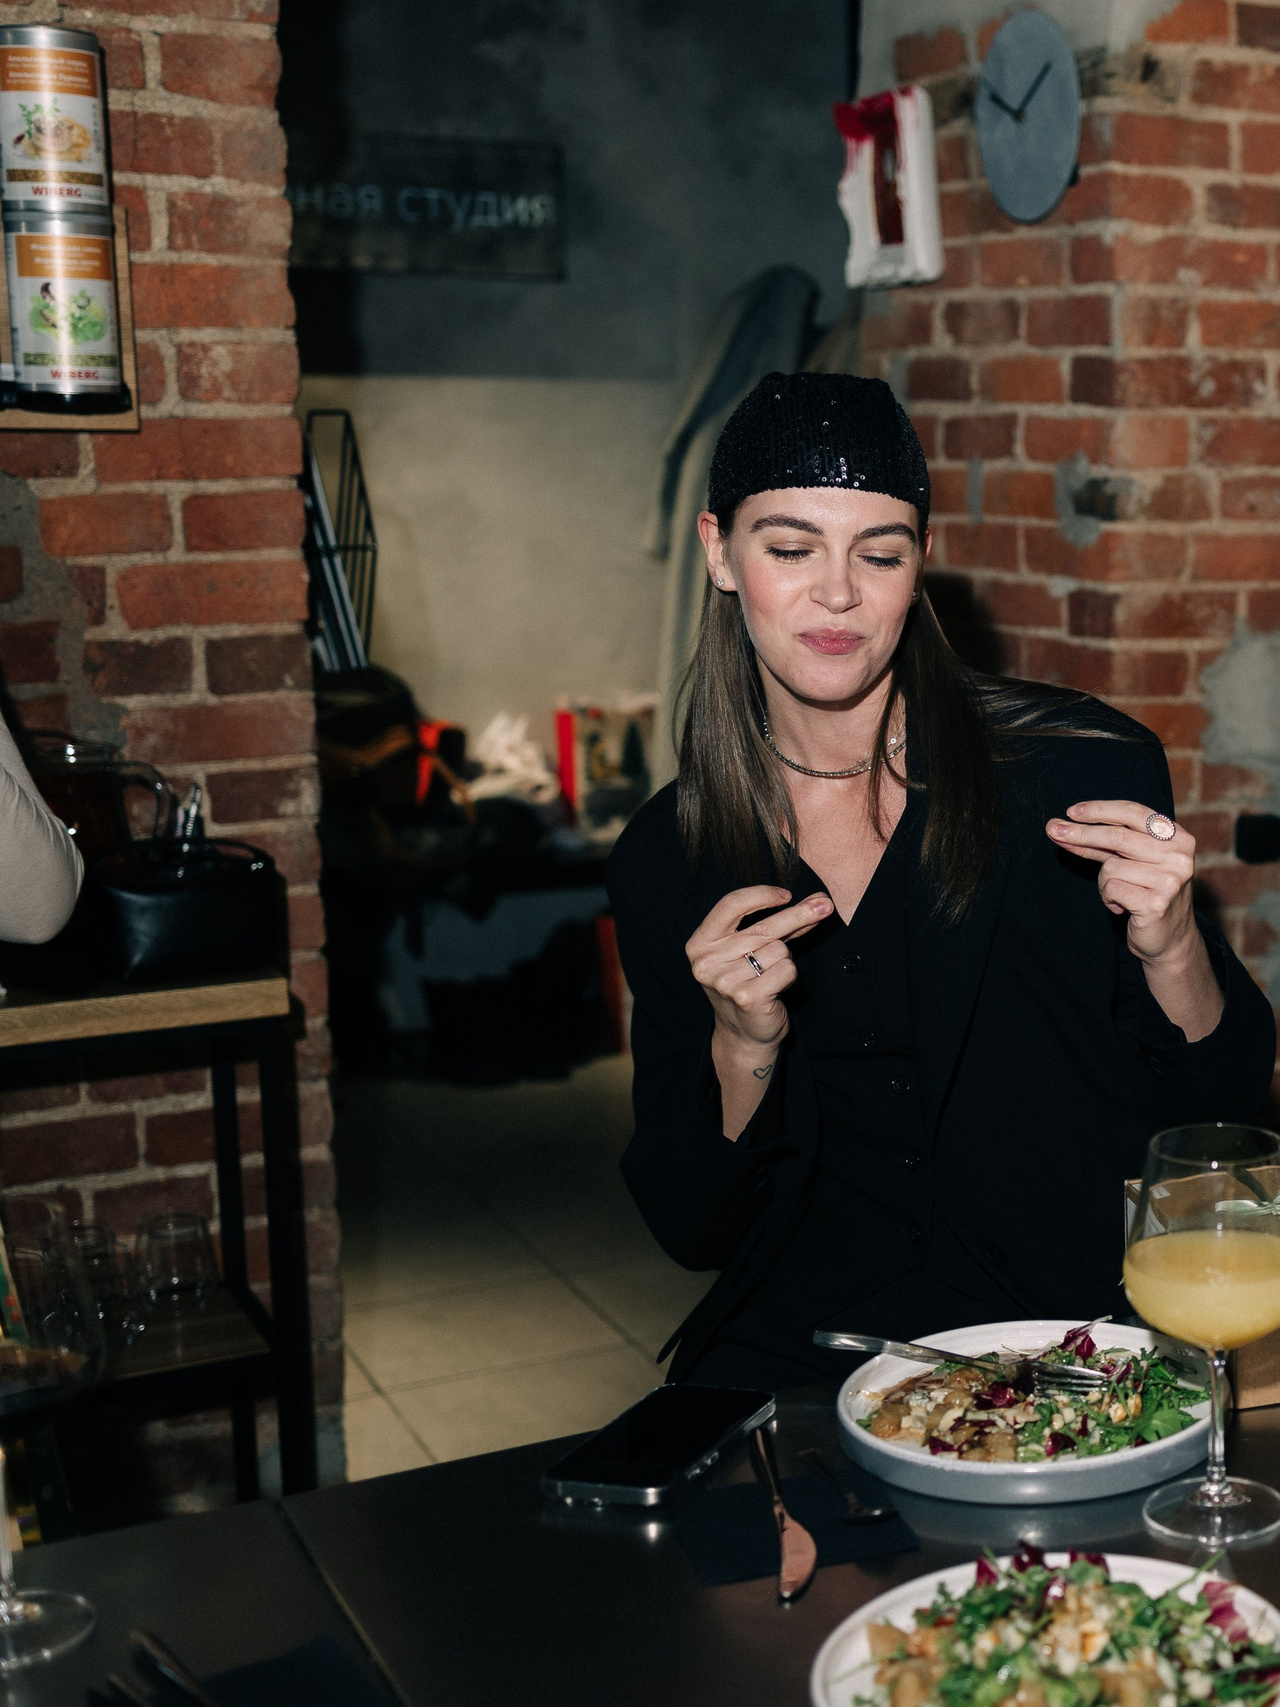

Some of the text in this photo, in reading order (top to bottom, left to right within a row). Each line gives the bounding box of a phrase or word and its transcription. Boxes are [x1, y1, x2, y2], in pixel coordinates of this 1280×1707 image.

[287, 180, 557, 234] ная студия
[50, 369, 99, 380] WBERG
